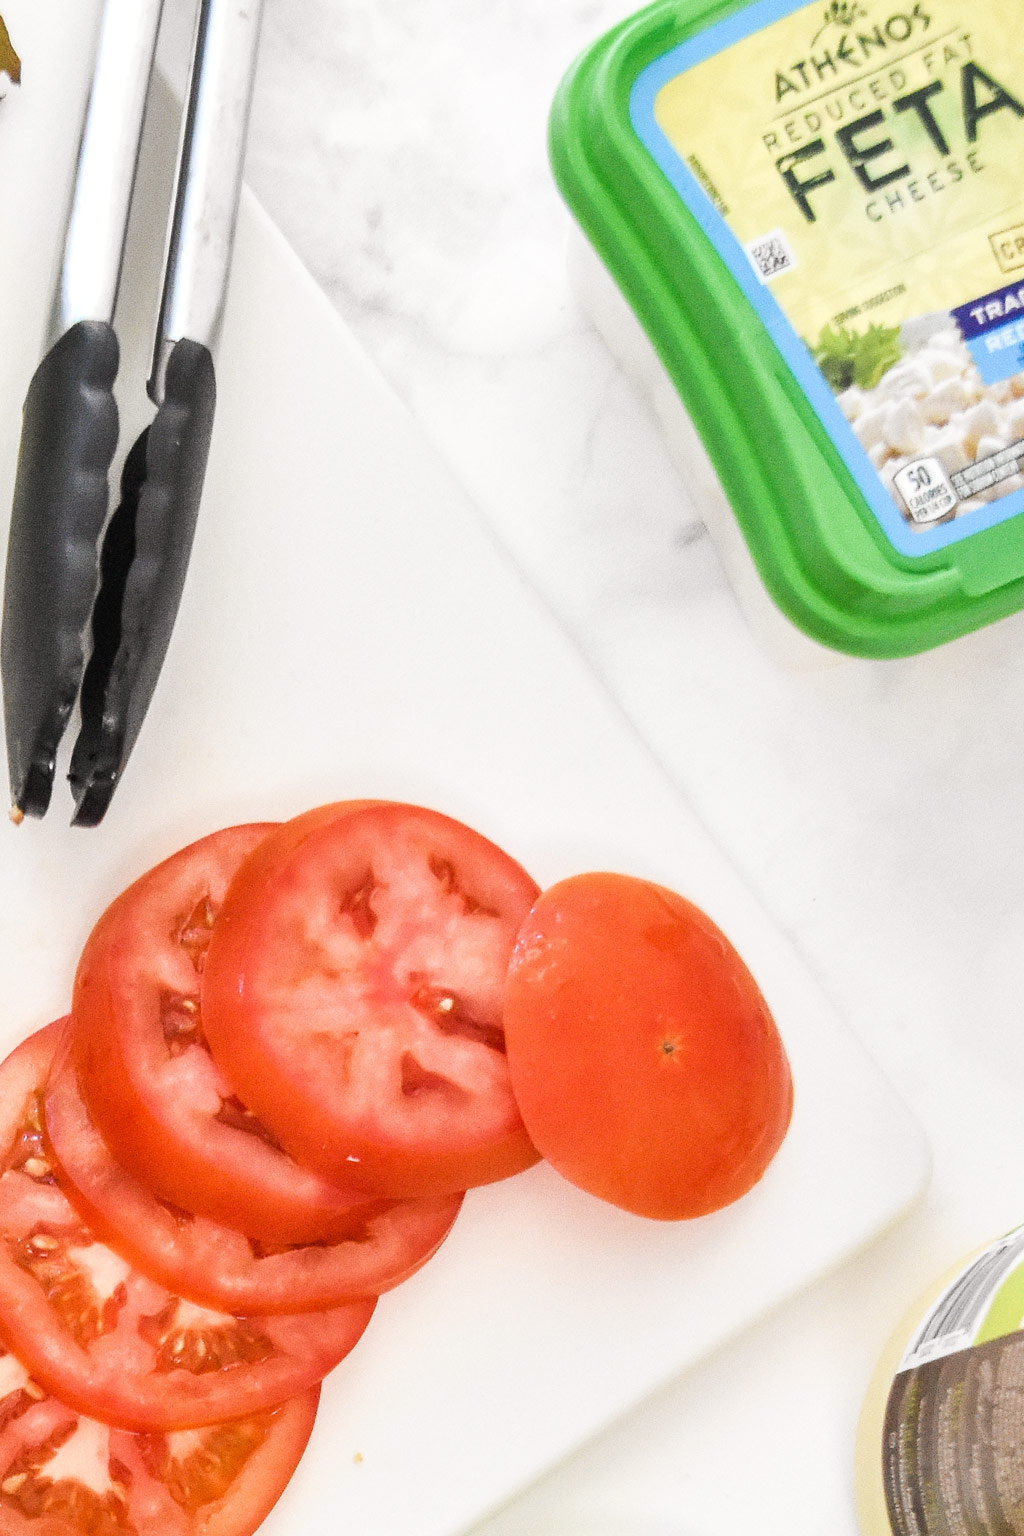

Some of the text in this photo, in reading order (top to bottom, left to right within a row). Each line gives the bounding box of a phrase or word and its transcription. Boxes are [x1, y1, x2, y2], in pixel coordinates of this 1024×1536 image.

[762, 33, 973, 153] REDUCED FAT
[775, 3, 931, 103] ATHENOS
[775, 61, 1024, 224] FETA
[865, 151, 985, 222] CHEESE
[907, 465, 932, 492] 50
